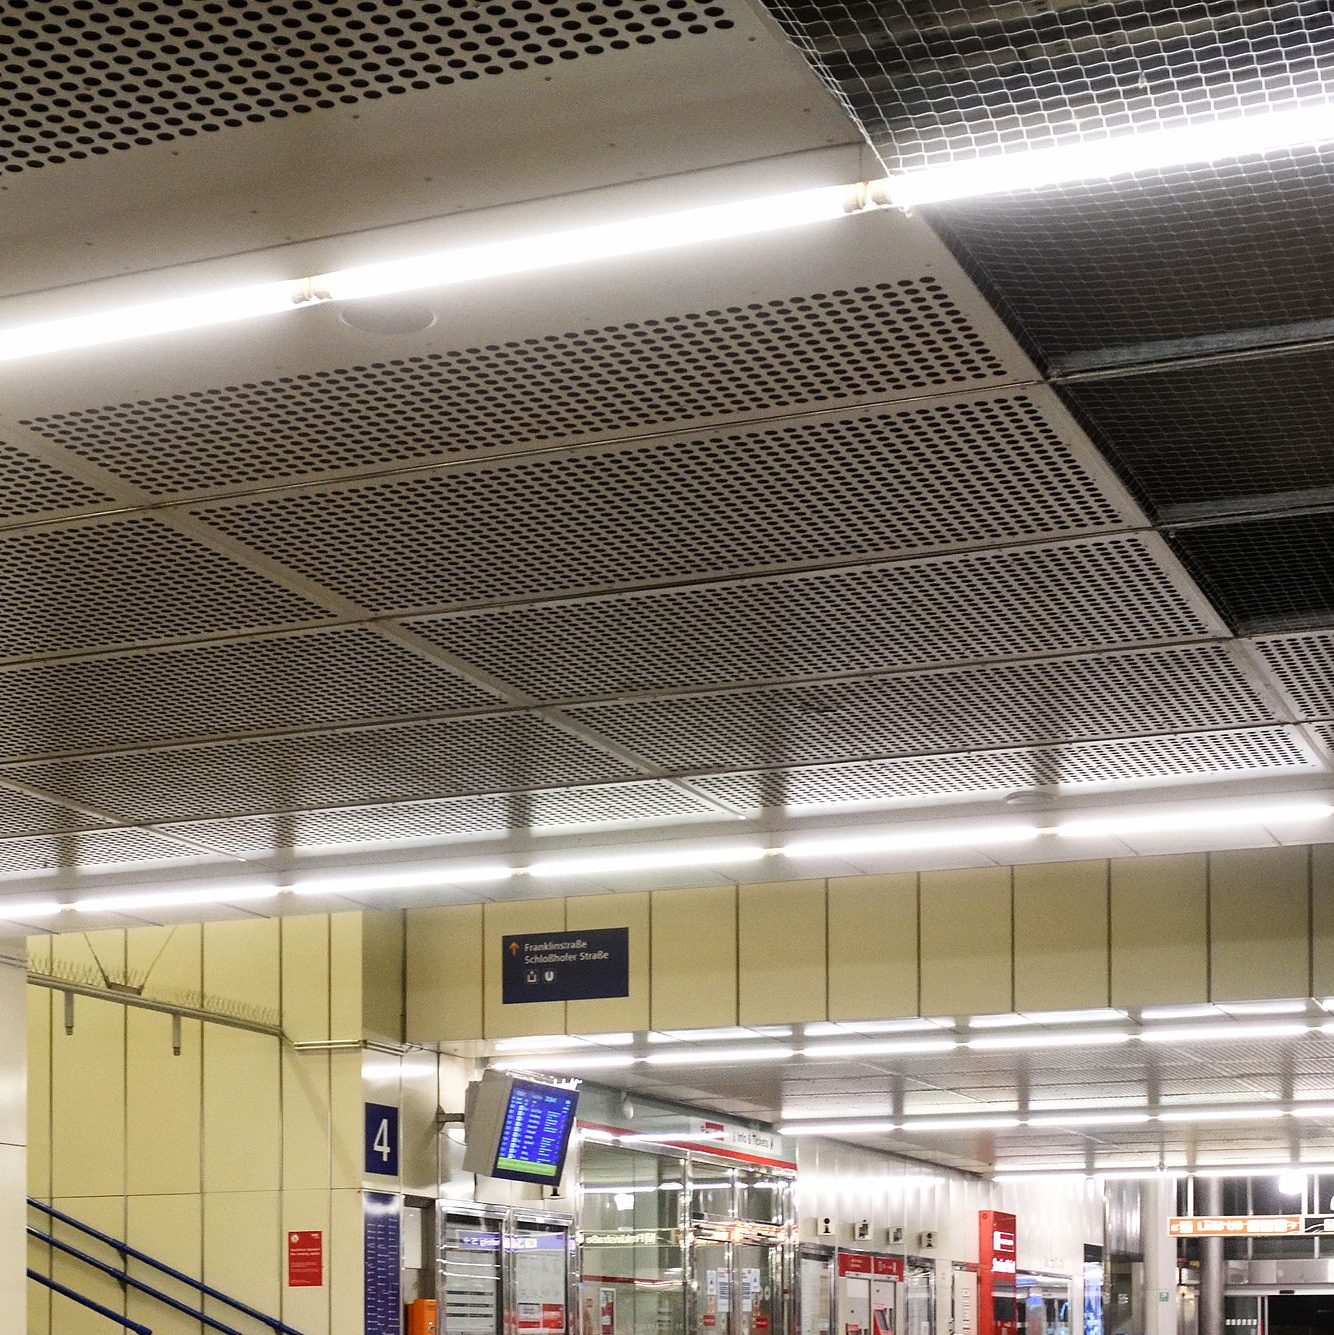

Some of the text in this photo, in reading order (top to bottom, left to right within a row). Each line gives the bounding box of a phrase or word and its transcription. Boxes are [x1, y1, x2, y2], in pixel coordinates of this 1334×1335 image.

[524, 940, 587, 952] Franklinstraße
[524, 950, 610, 965] Schloßhofer Straße
[373, 1118, 391, 1162] 4
